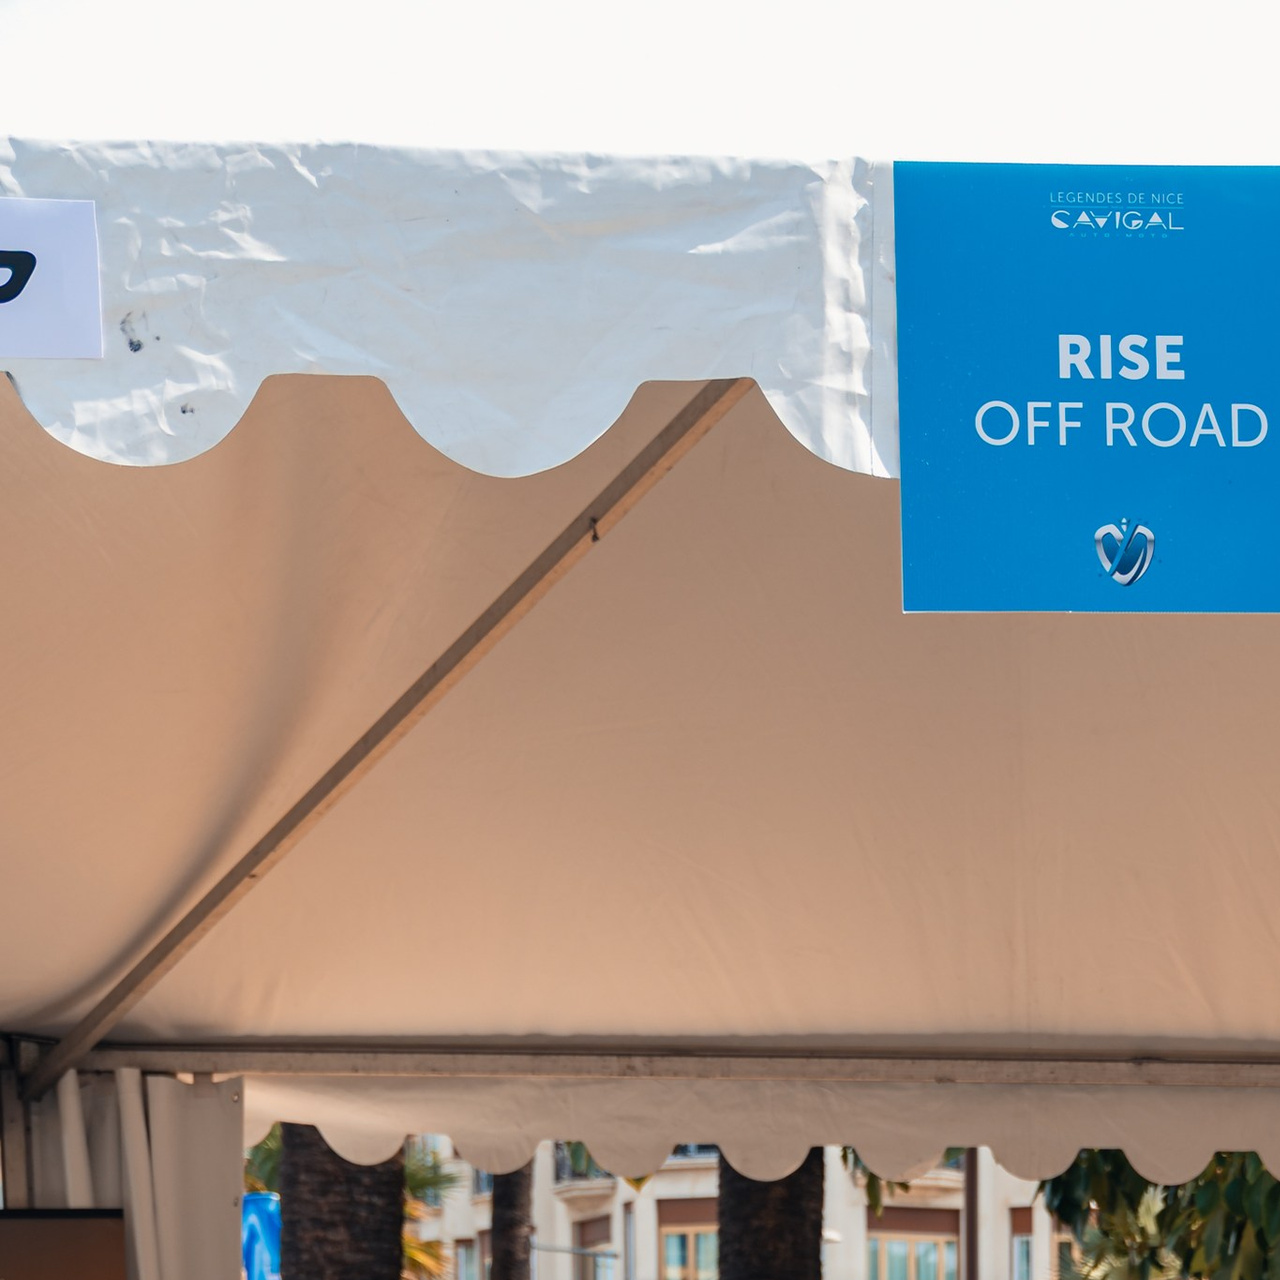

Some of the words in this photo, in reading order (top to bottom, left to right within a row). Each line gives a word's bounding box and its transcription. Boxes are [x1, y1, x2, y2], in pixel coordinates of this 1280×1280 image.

[1050, 192, 1122, 204] LEGENDES
[1128, 193, 1145, 204] DE
[1151, 193, 1184, 204] NICE
[1051, 210, 1185, 230] CAVIGAL
[1058, 333, 1185, 380] RISE
[975, 400, 1083, 447] OFF
[1107, 402, 1268, 448] ROAD
